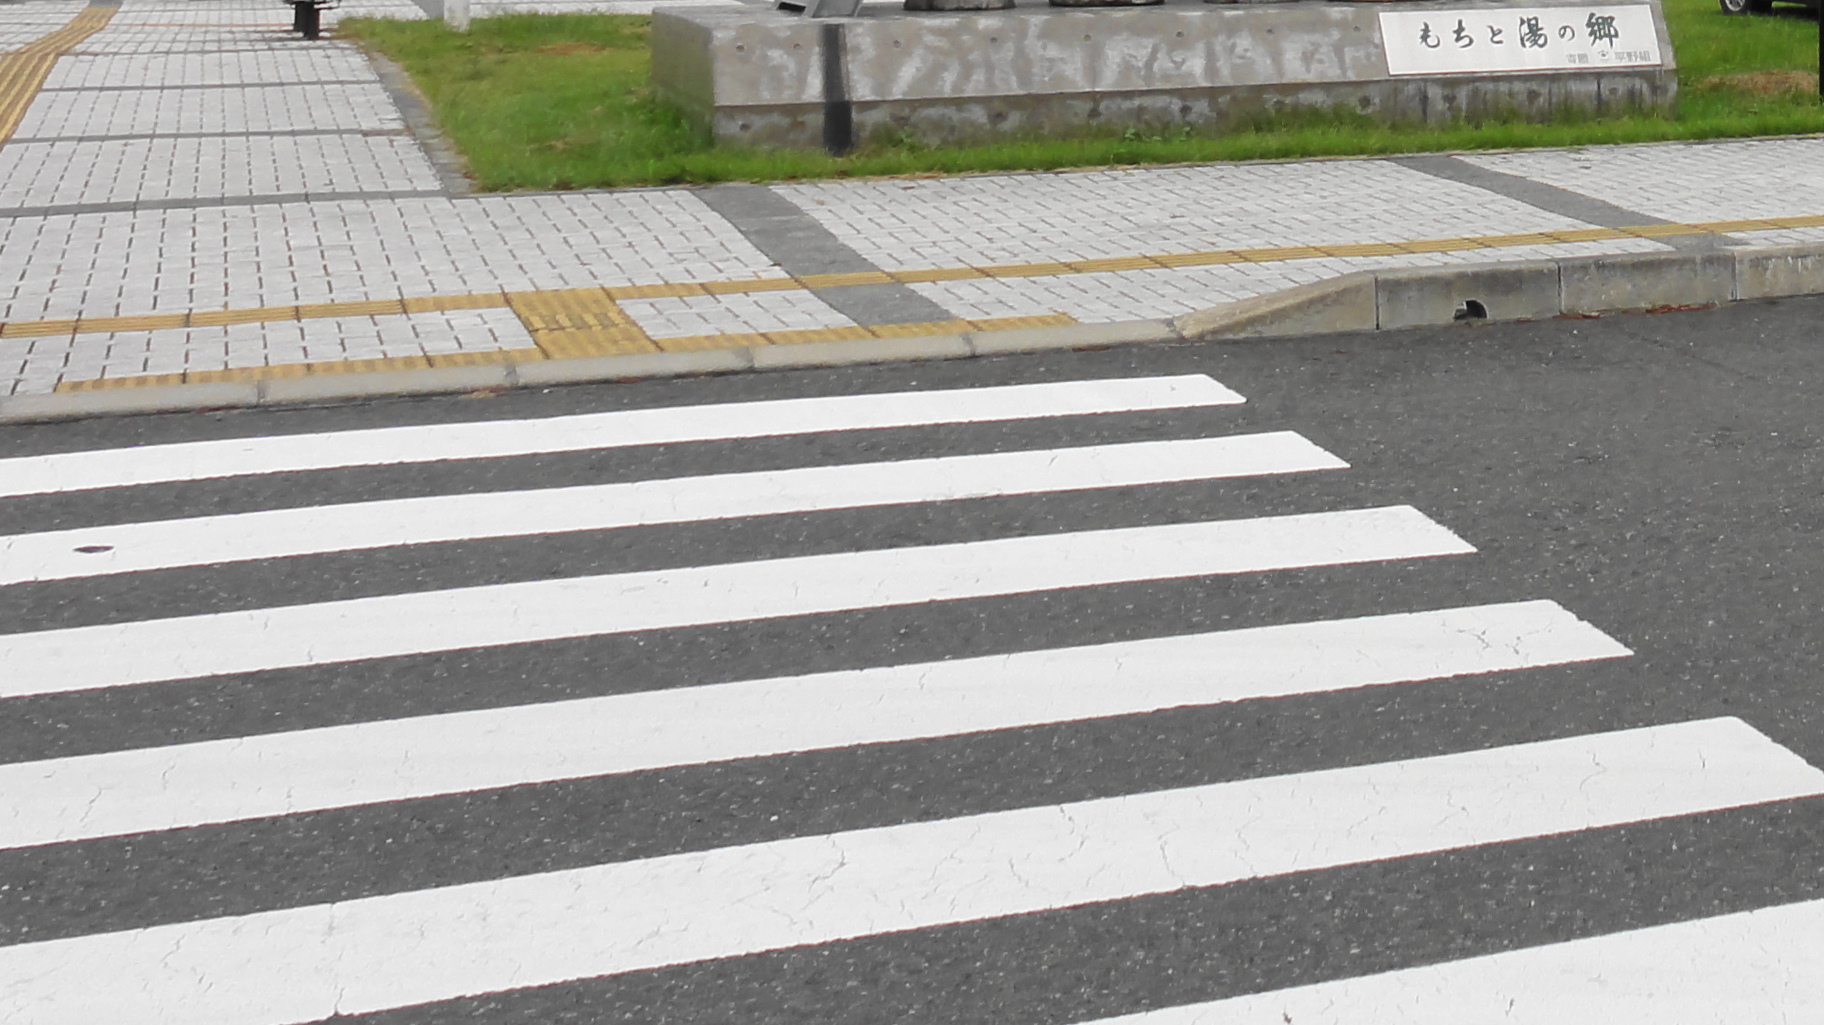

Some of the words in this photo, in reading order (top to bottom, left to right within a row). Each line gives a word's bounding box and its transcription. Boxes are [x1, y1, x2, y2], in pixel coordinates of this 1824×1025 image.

[1417, 11, 1621, 50] もちと湯の郷
